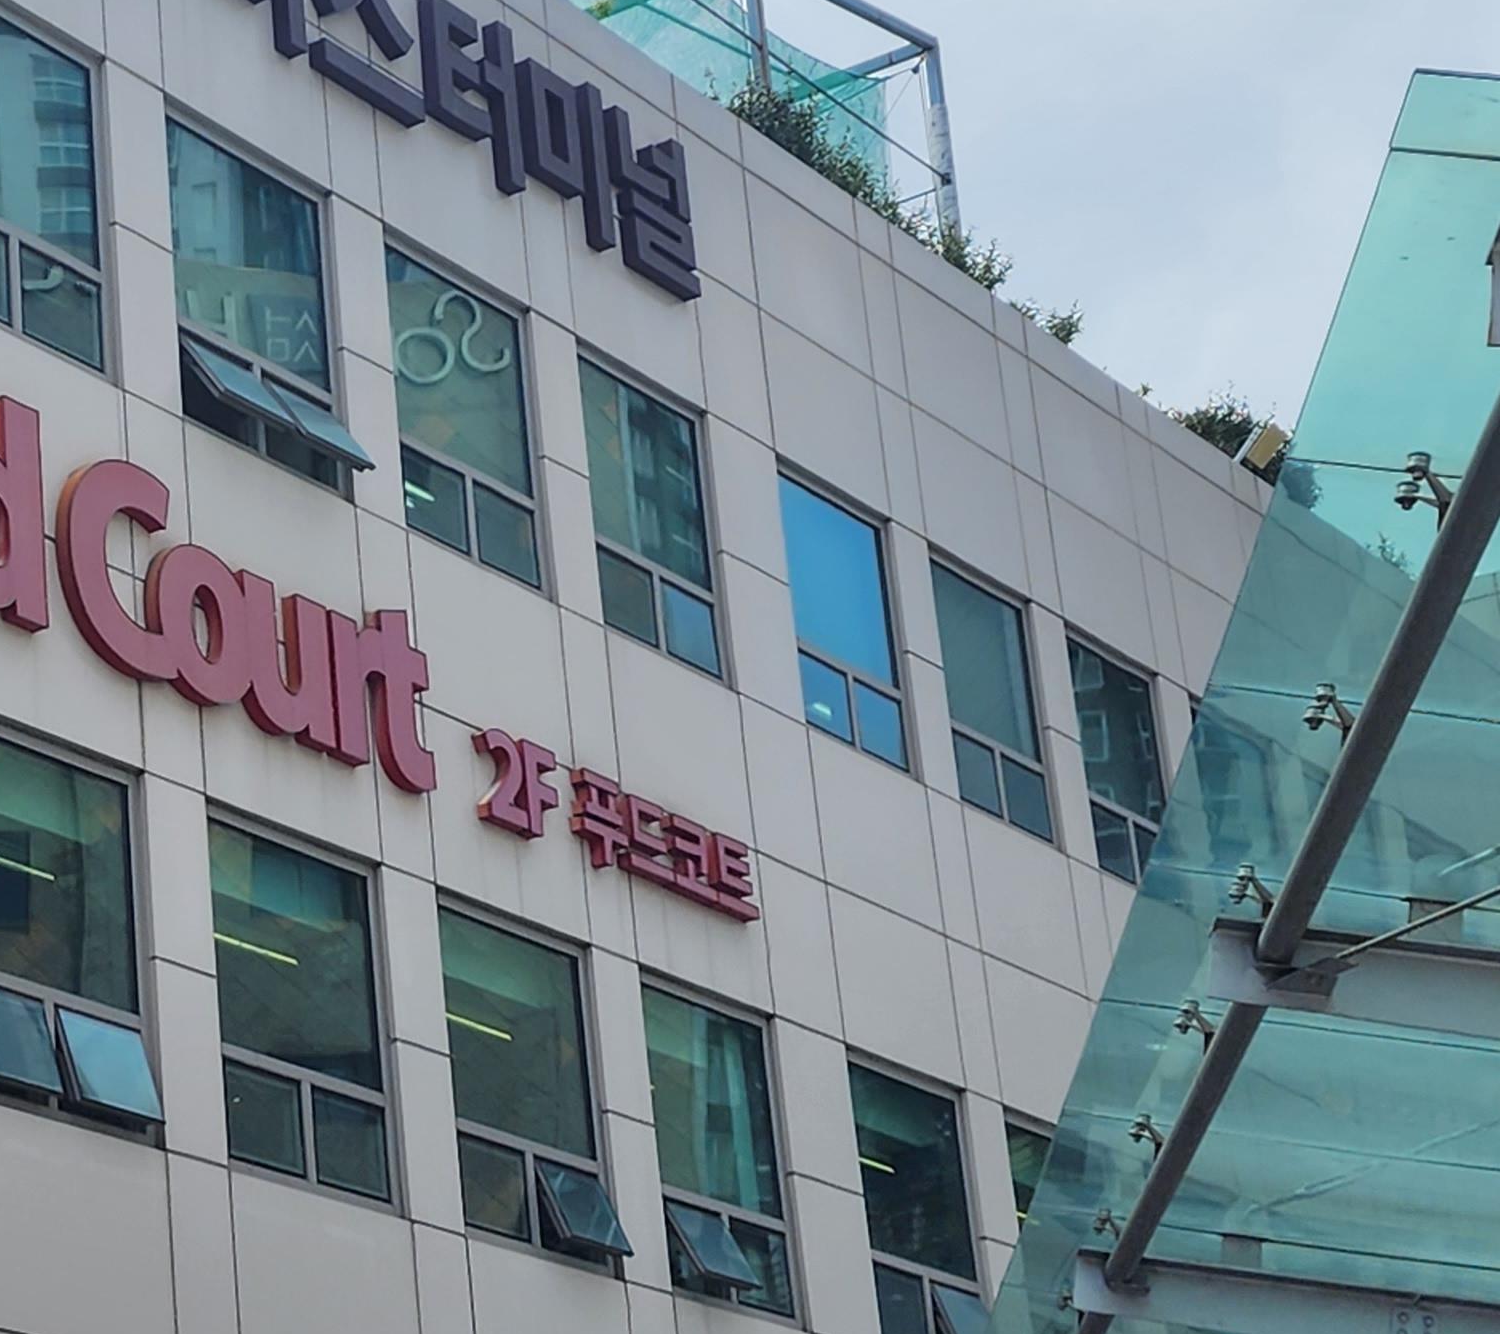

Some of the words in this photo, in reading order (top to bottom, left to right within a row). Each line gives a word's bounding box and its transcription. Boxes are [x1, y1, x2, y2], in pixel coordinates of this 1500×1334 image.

[55, 457, 436, 794] Court
[472, 727, 558, 839] 2F
[569, 766, 760, 923] 푸드코트
